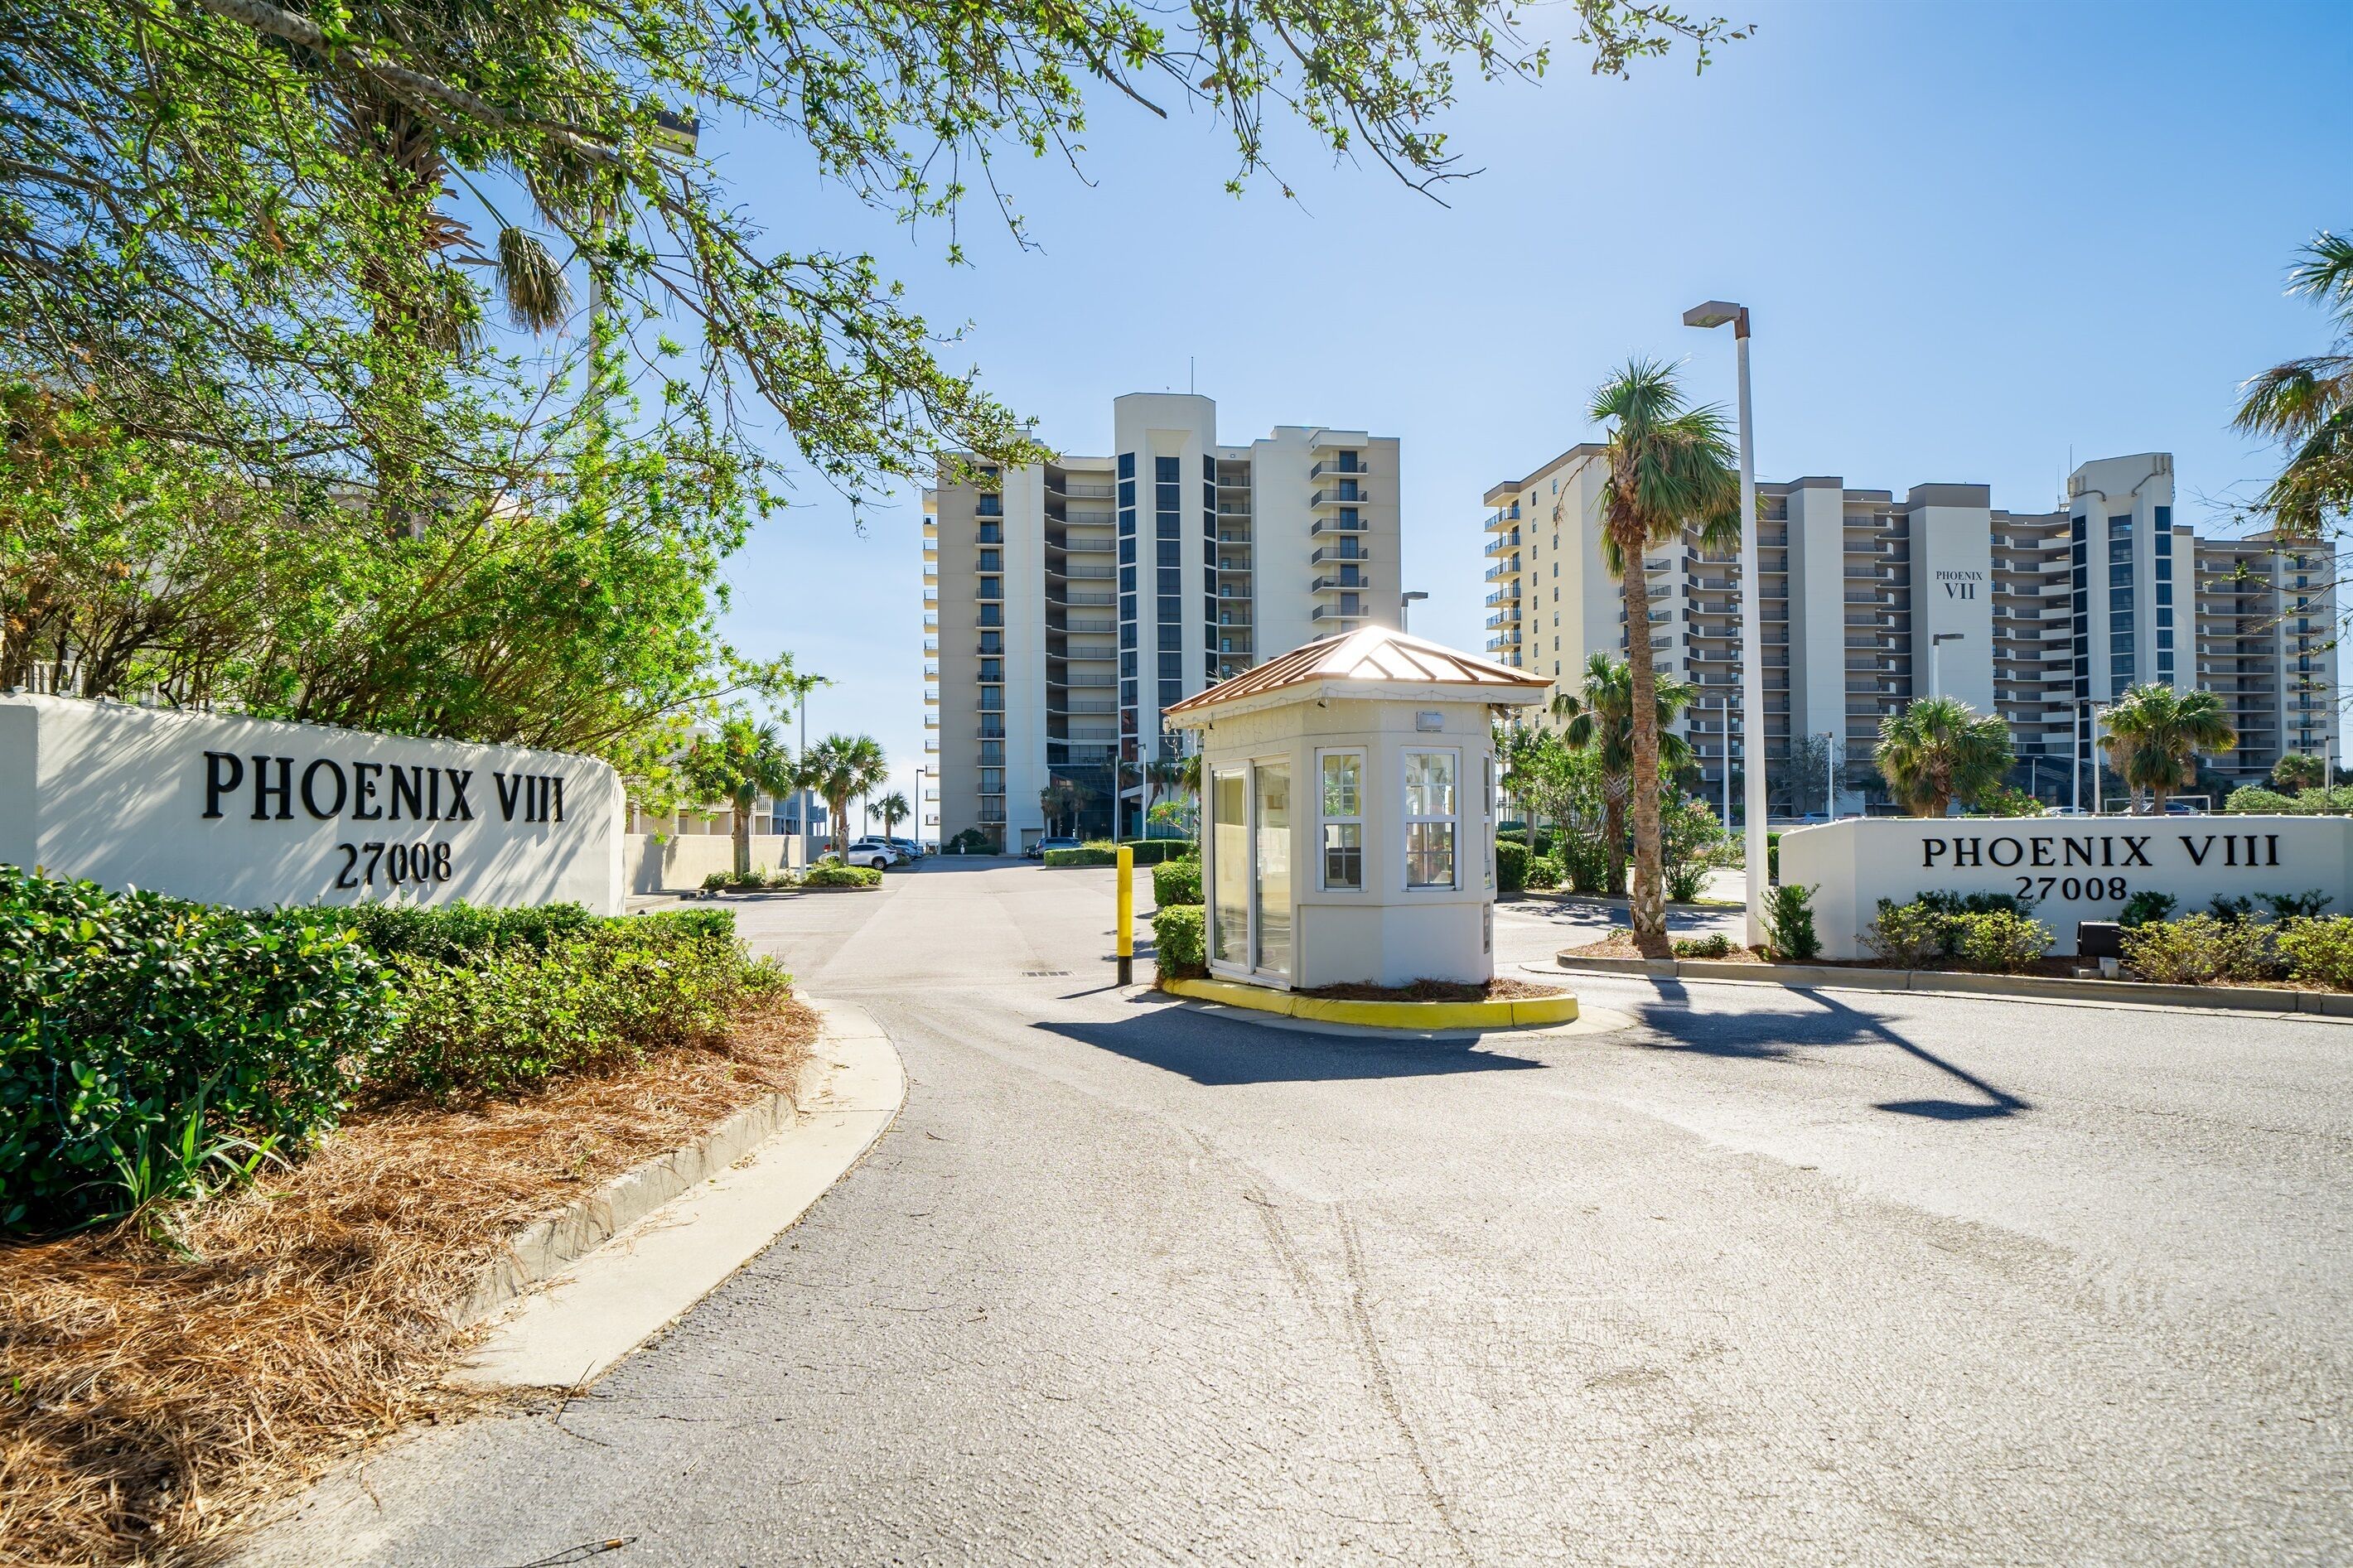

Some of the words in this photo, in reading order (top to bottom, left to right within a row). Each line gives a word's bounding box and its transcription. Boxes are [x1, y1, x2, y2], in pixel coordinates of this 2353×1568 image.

[1935, 571, 1983, 581] PHOENIX
[1944, 582, 1975, 600] VII
[201, 750, 476, 822] PHOENIX
[492, 770, 565, 823] VIII
[335, 841, 452, 890] 27008
[1921, 836, 2153, 868] PHOENIX
[2178, 834, 2281, 867] VIII
[2015, 876, 2128, 901] 27008
